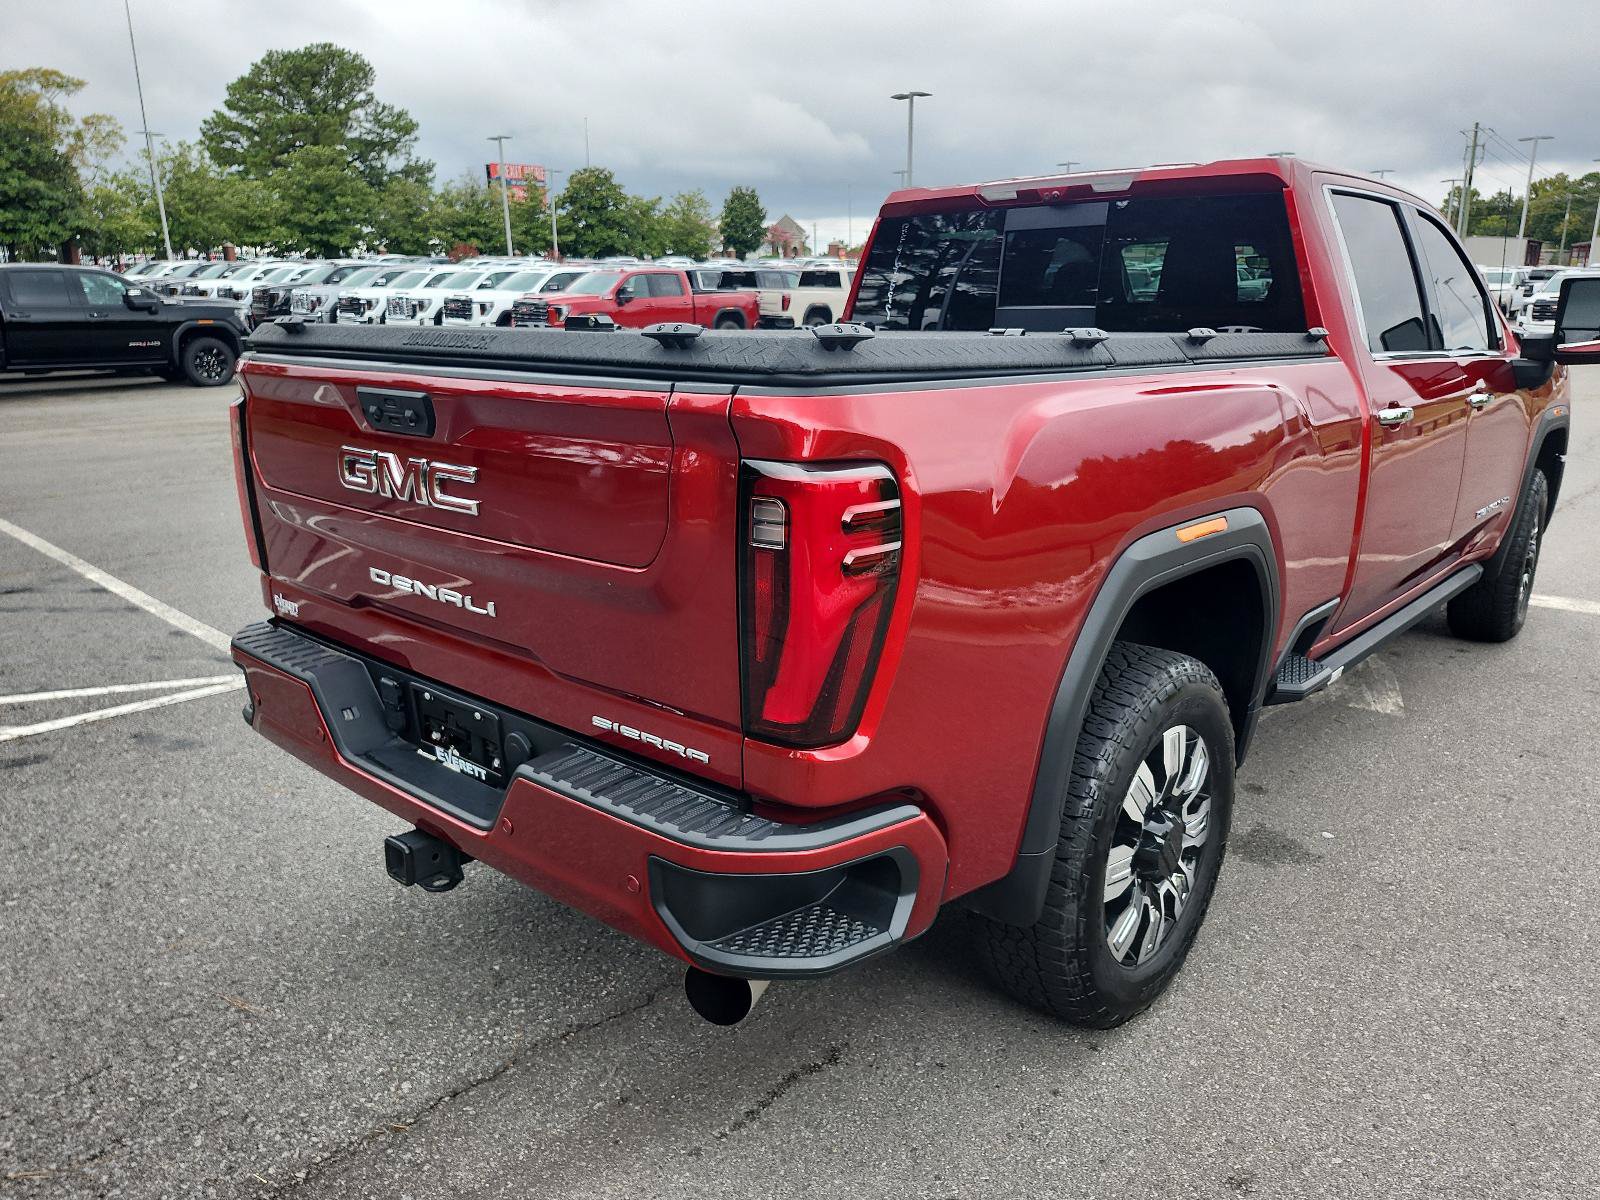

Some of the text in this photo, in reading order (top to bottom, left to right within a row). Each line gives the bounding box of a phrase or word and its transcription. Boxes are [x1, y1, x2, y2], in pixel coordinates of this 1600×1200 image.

[337, 445, 480, 516] GMC
[369, 566, 497, 618] DENALI
[434, 745, 487, 781] EVERETT
[591, 714, 711, 764] SIERRA
